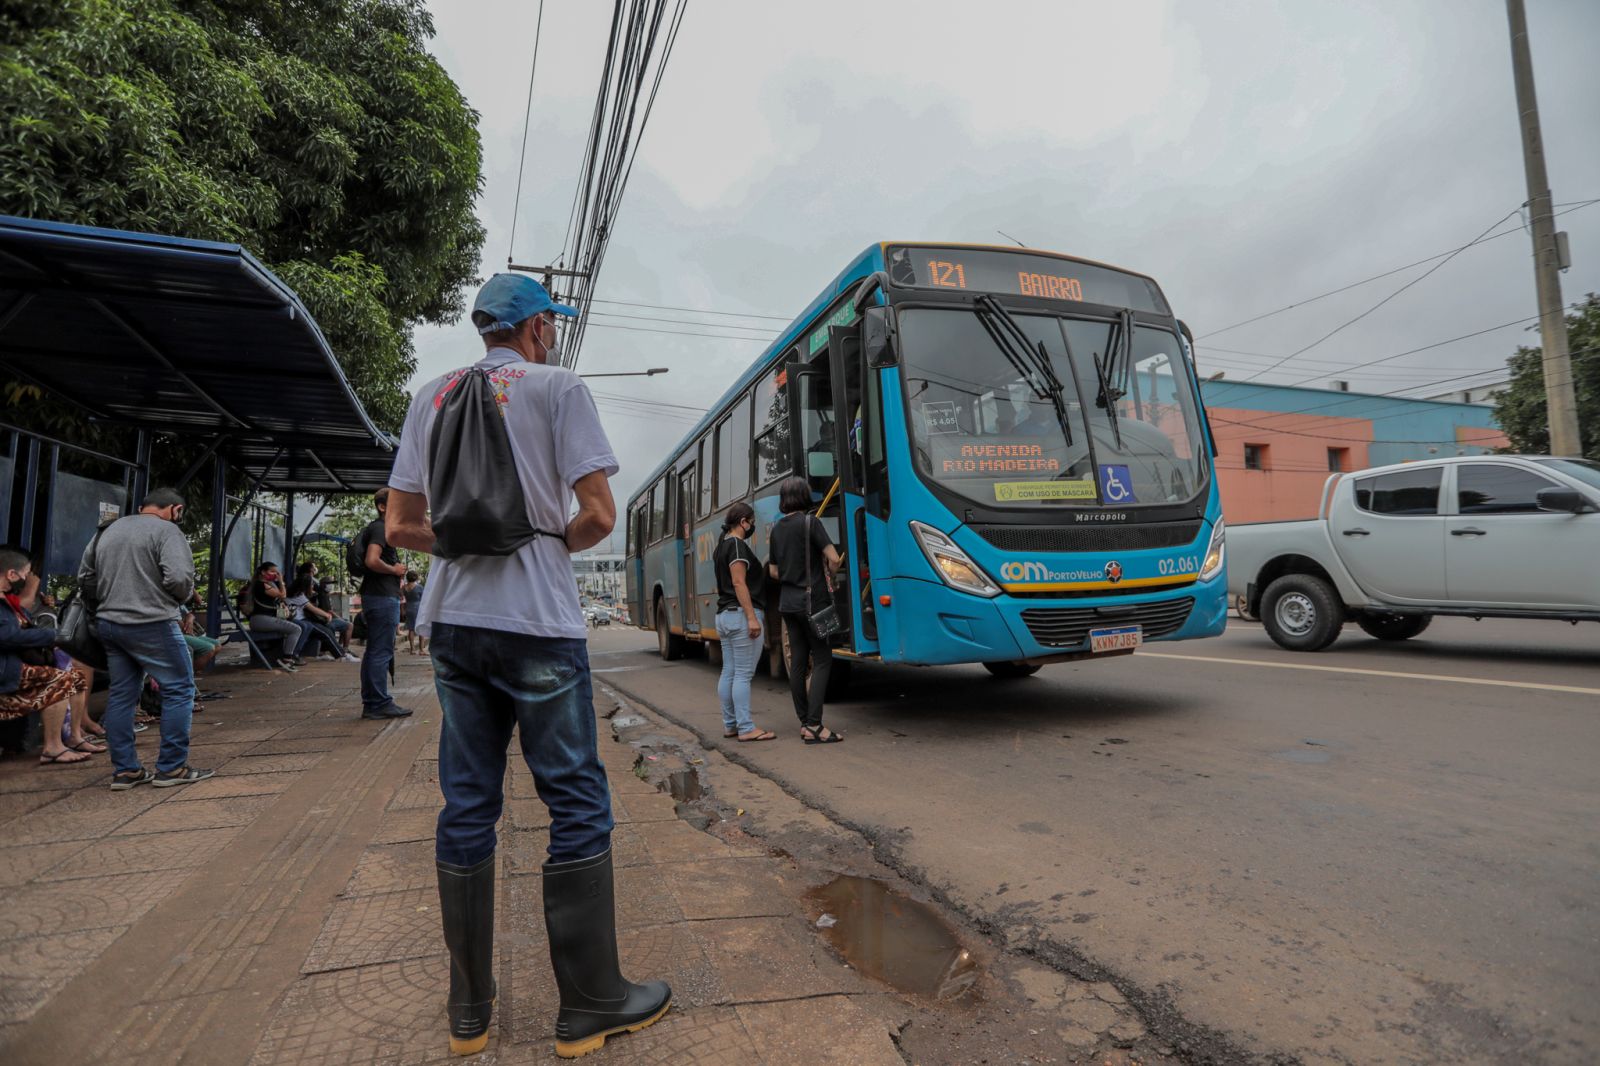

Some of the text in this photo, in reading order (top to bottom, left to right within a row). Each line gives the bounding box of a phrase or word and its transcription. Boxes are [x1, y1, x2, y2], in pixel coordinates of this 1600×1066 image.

[928, 260, 1083, 301] 121 BAIRRO
[961, 445, 1042, 457] AVENIDA
[943, 459, 1059, 472] RIO MADEIRA
[1075, 513, 1127, 522] Marcopolo
[1158, 555, 1199, 575] 02.061
